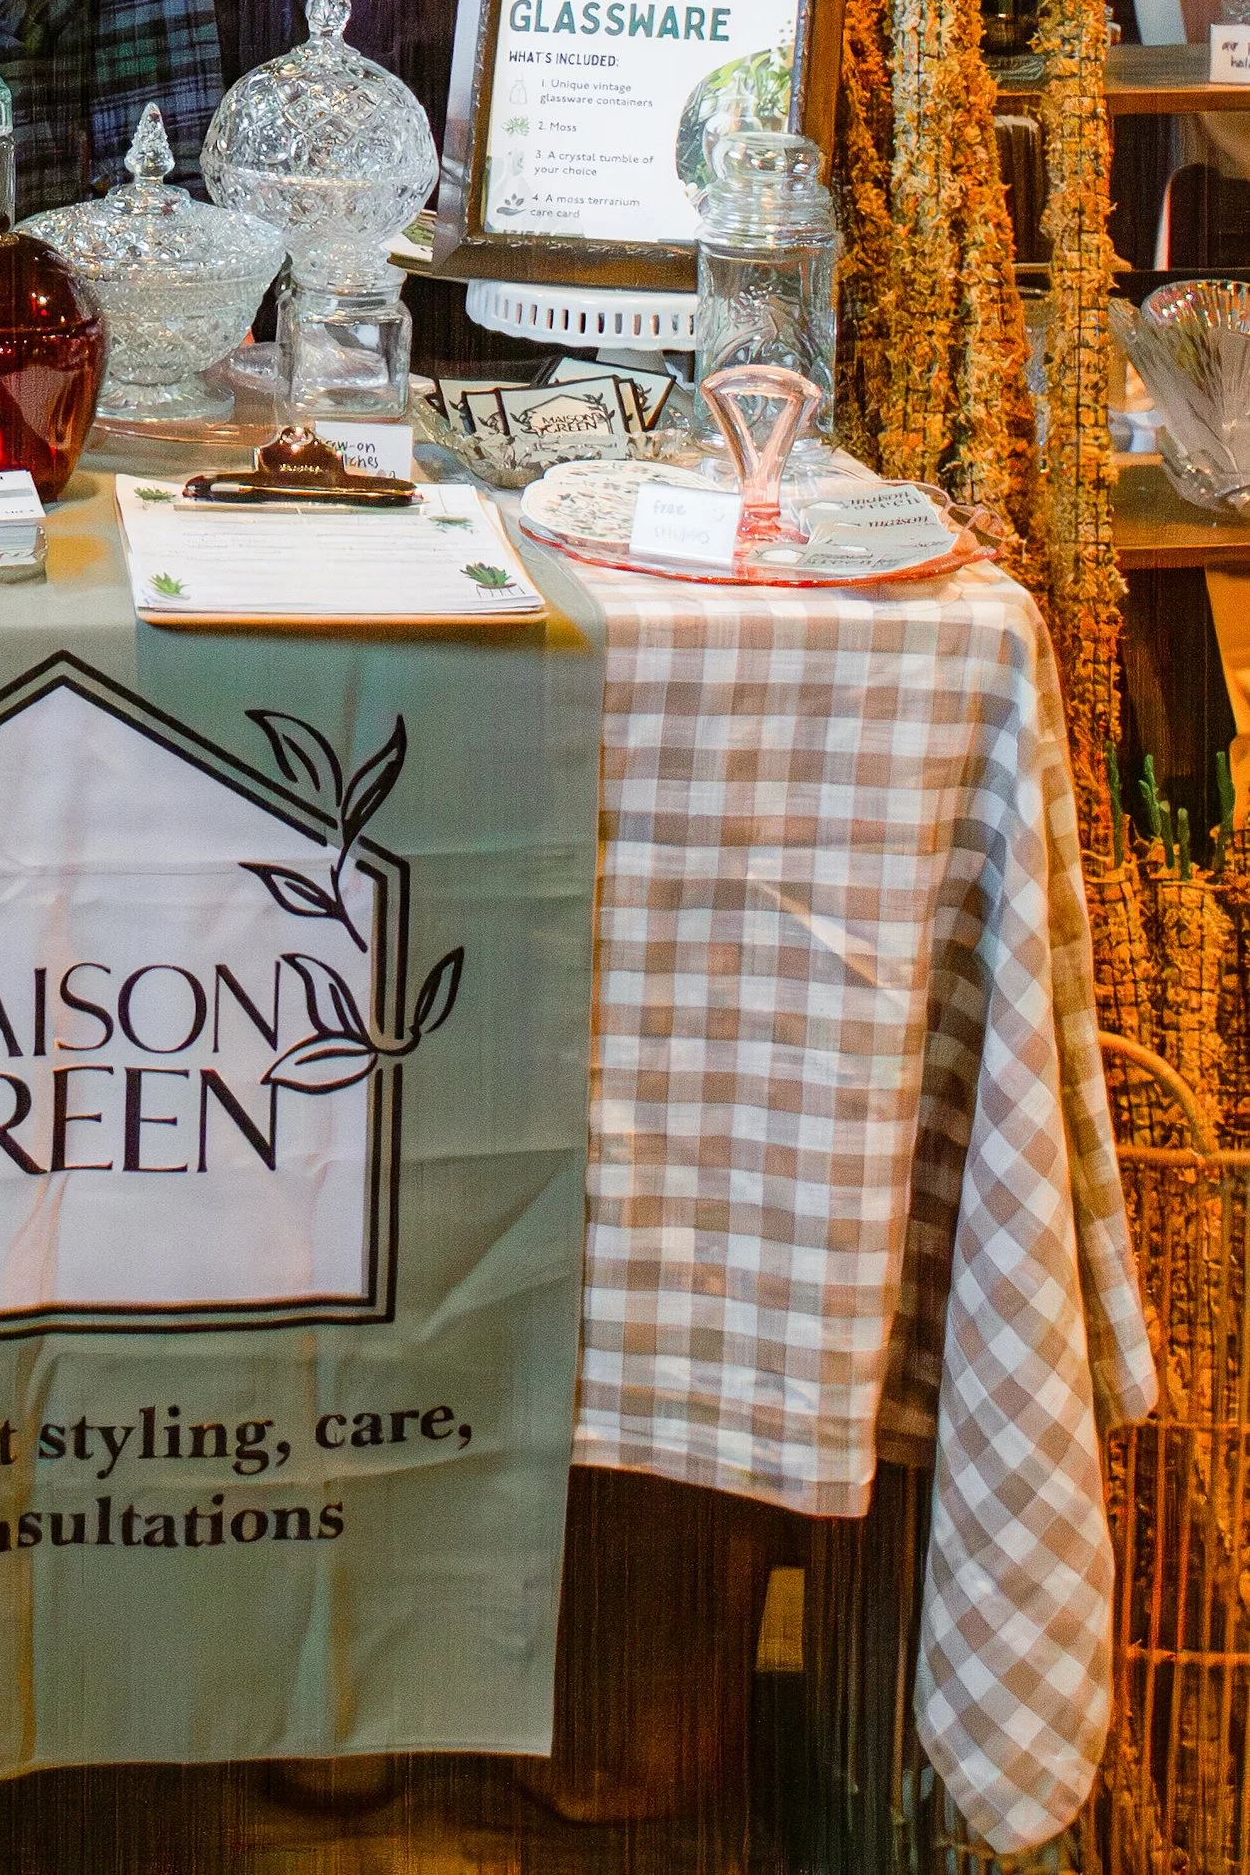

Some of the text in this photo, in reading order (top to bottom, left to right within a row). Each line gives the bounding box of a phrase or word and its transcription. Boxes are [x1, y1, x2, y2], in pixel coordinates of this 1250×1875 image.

[509, 0, 731, 42] GLASSWARE
[509, 51, 619, 67] WHAT'S INCLUDED:
[550, 79, 590, 91] Unique
[593, 82, 632, 94] vintage
[540, 93, 654, 108] glassware containers
[550, 122, 577, 132] Moss
[547, 150, 556, 159] A
[558, 151, 596, 163] crystal
[599, 154, 639, 164] tumble
[642, 155, 655, 164] of
[534, 166, 598, 176] your choice
[545, 194, 553, 202] A
[556, 196, 585, 205] moss
[587, 195, 641, 207] terrarium
[530, 208, 581, 219] care card
[541, 412, 600, 425] MAISON
[544, 421, 598, 434] GREEN
[653, 499, 686, 515] free
[37, 1405, 291, 1480] styling,
[312, 1402, 474, 1452] care,
